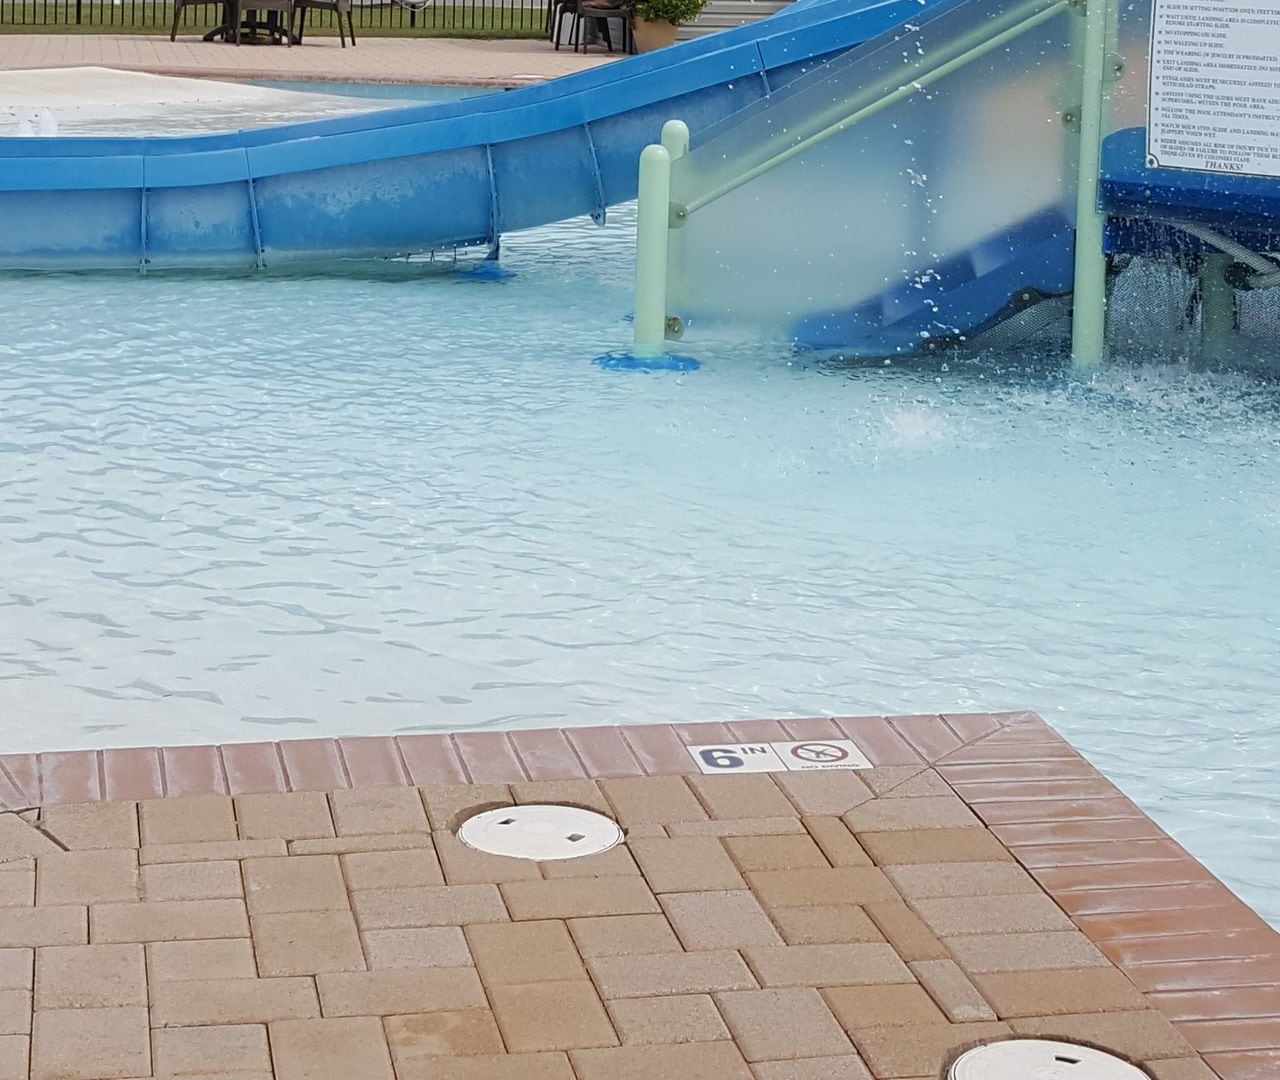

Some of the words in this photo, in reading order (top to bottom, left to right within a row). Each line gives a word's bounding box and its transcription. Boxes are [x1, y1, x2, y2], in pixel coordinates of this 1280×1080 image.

[1204, 160, 1243, 170] THANKS!
[699, 748, 744, 769] 6
[741, 747, 768, 755] IN
